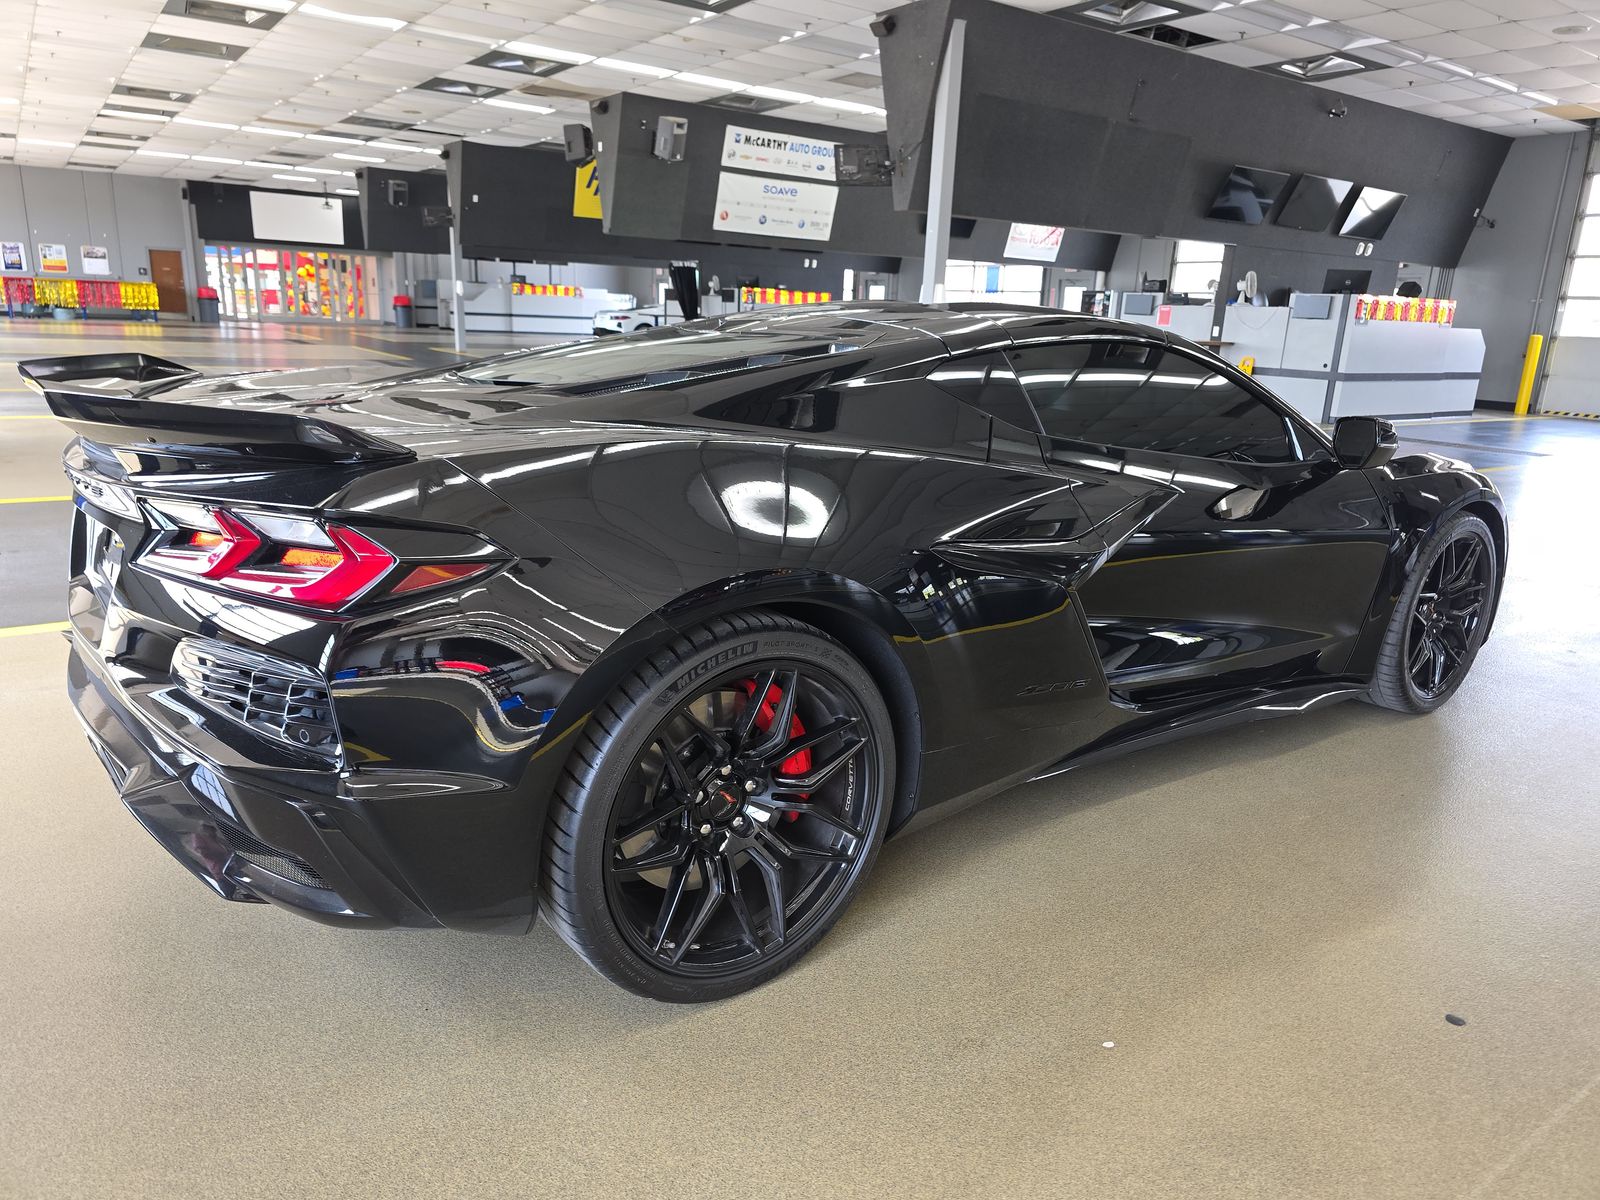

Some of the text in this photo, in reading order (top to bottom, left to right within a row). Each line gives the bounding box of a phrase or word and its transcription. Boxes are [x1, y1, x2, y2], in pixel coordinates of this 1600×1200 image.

[744, 135, 835, 158] McCARTHY AUTO GROU
[676, 642, 755, 689] MICHELIN
